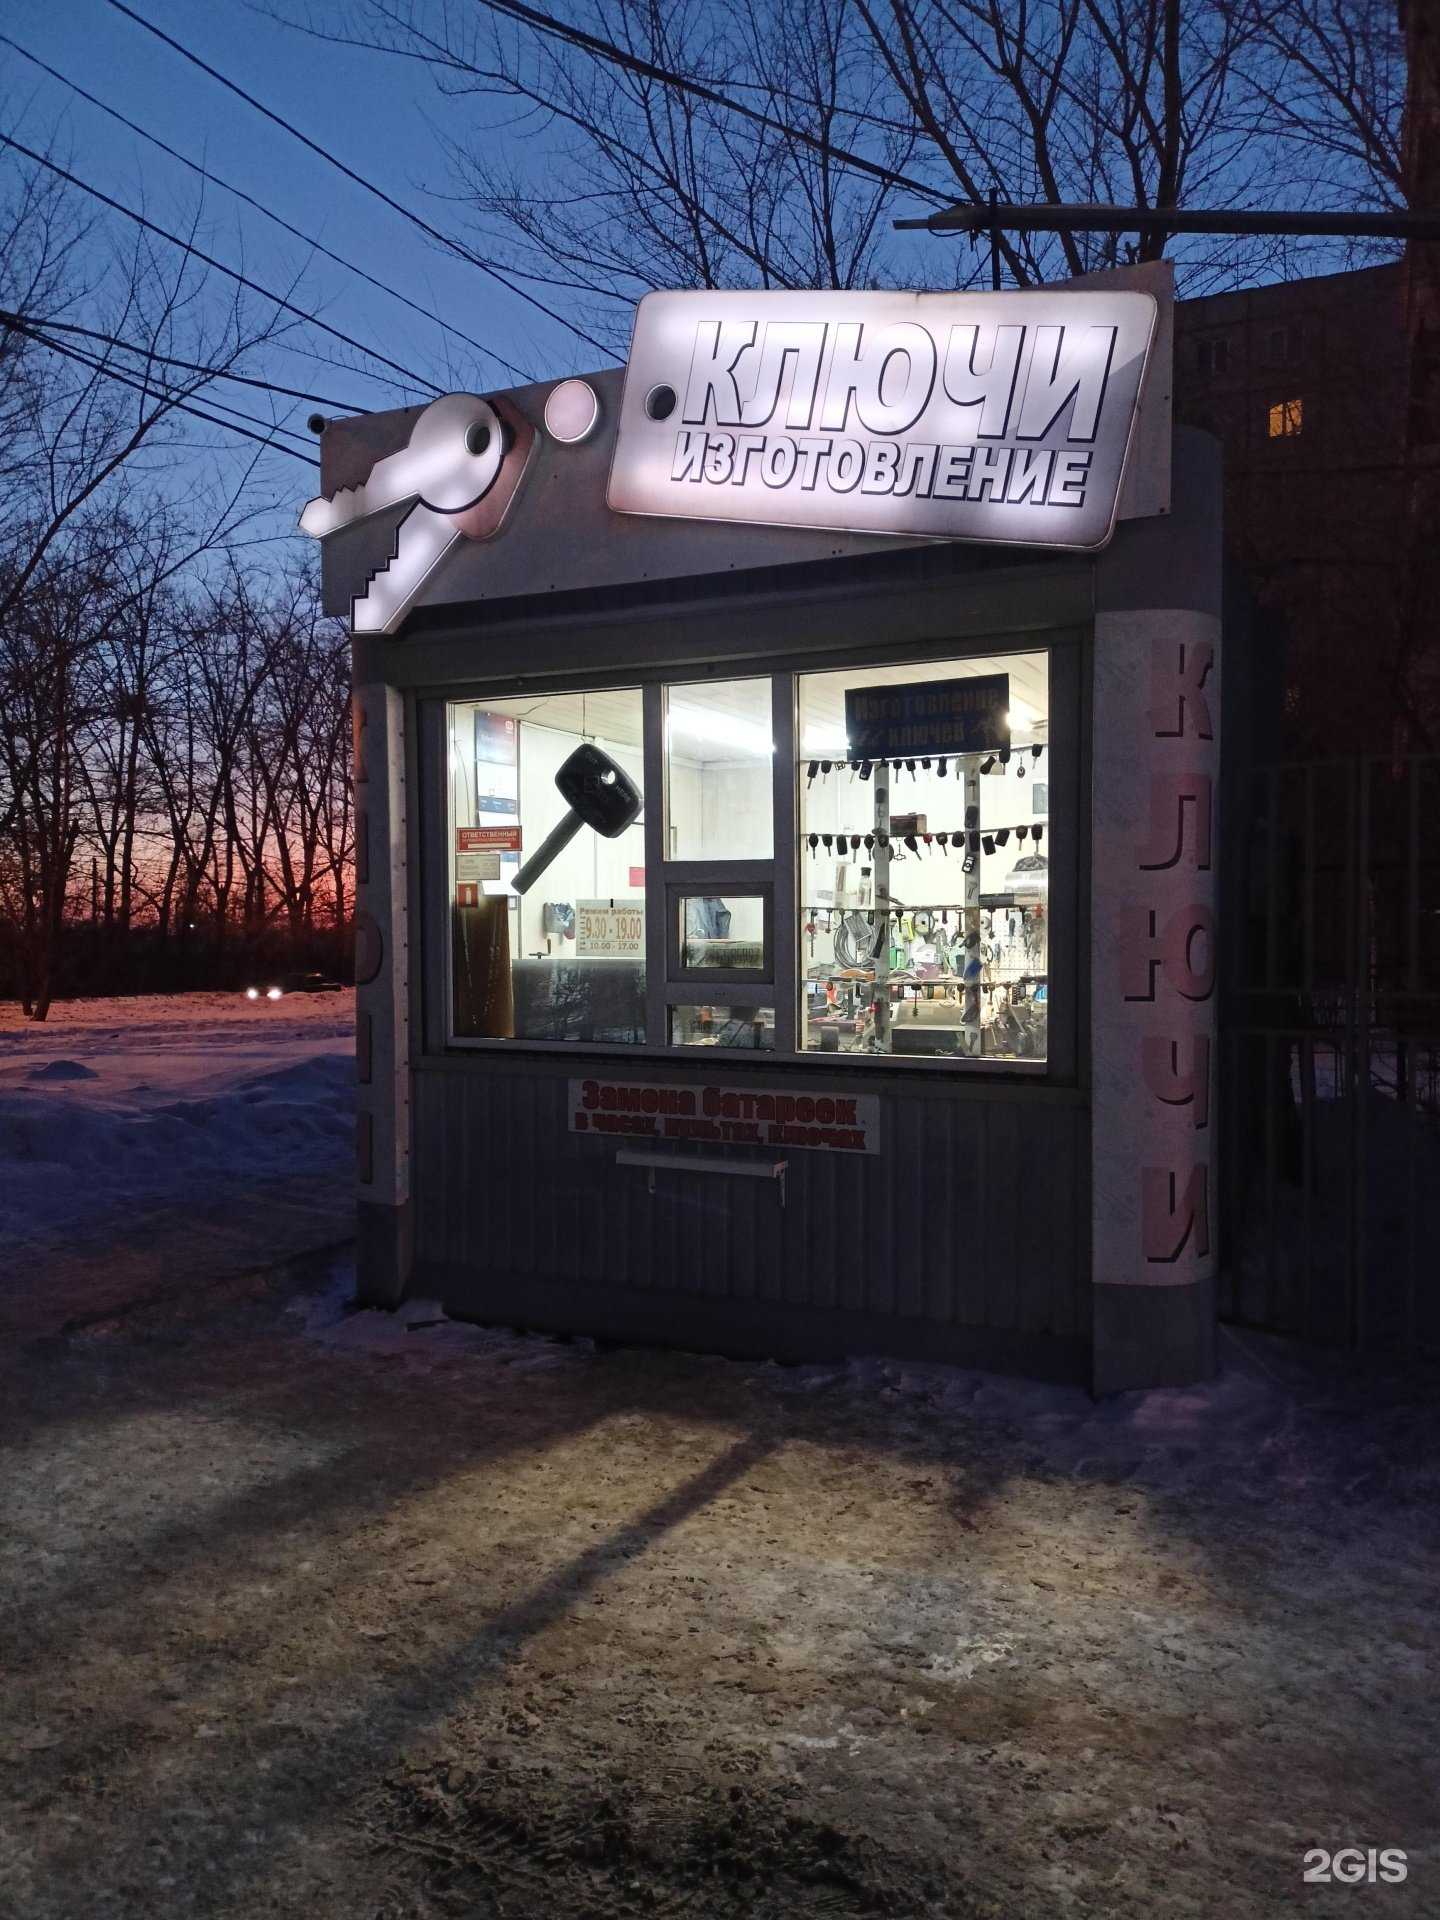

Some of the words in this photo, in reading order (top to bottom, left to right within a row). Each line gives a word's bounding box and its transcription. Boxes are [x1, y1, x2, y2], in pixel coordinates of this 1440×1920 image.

[682, 320, 1118, 443] КЛЮЧИ
[671, 431, 1093, 507] ИЗГОТОВЛЕНИЕ
[616, 916, 642, 940] 19.00
[1120, 637, 1216, 1263] КЛЮЧИ
